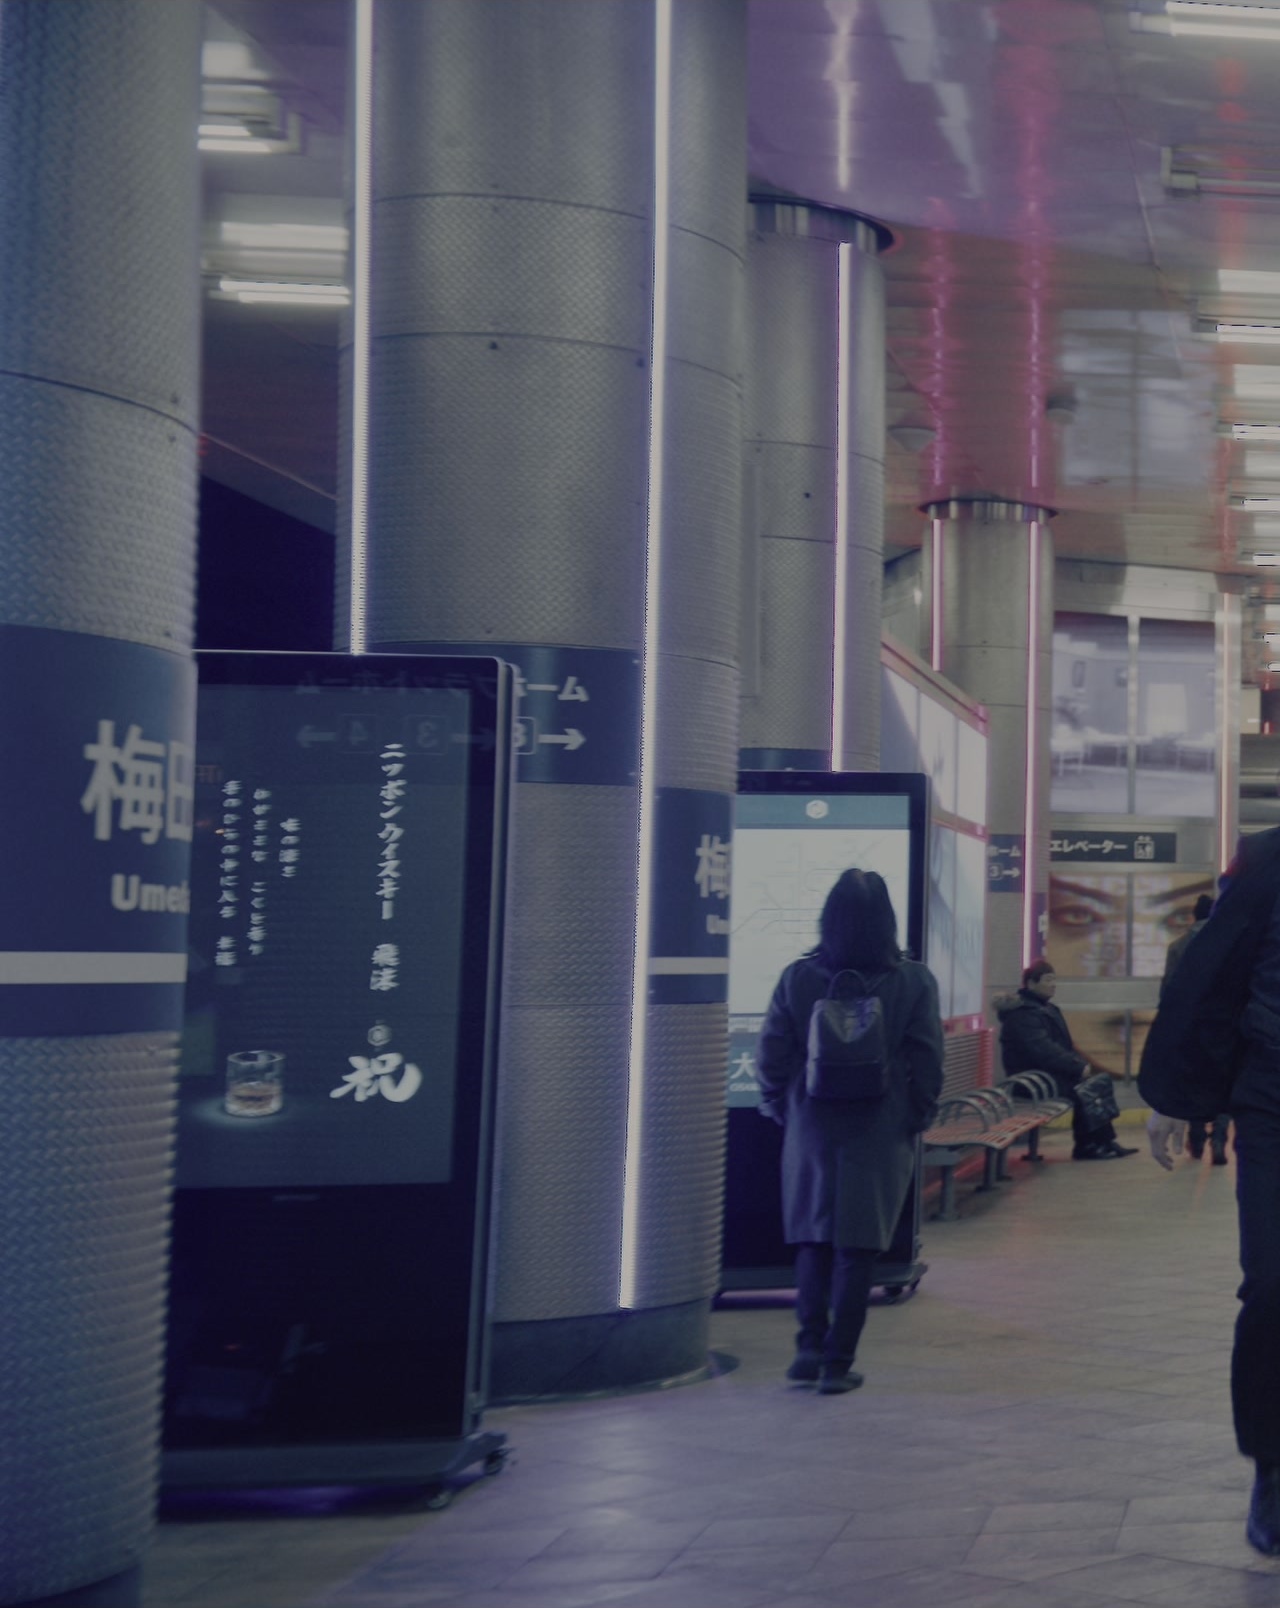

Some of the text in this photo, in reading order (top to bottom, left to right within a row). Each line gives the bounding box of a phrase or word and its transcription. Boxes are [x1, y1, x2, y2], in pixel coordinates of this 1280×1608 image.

[1050, 839, 1127, 854] エレベーター
